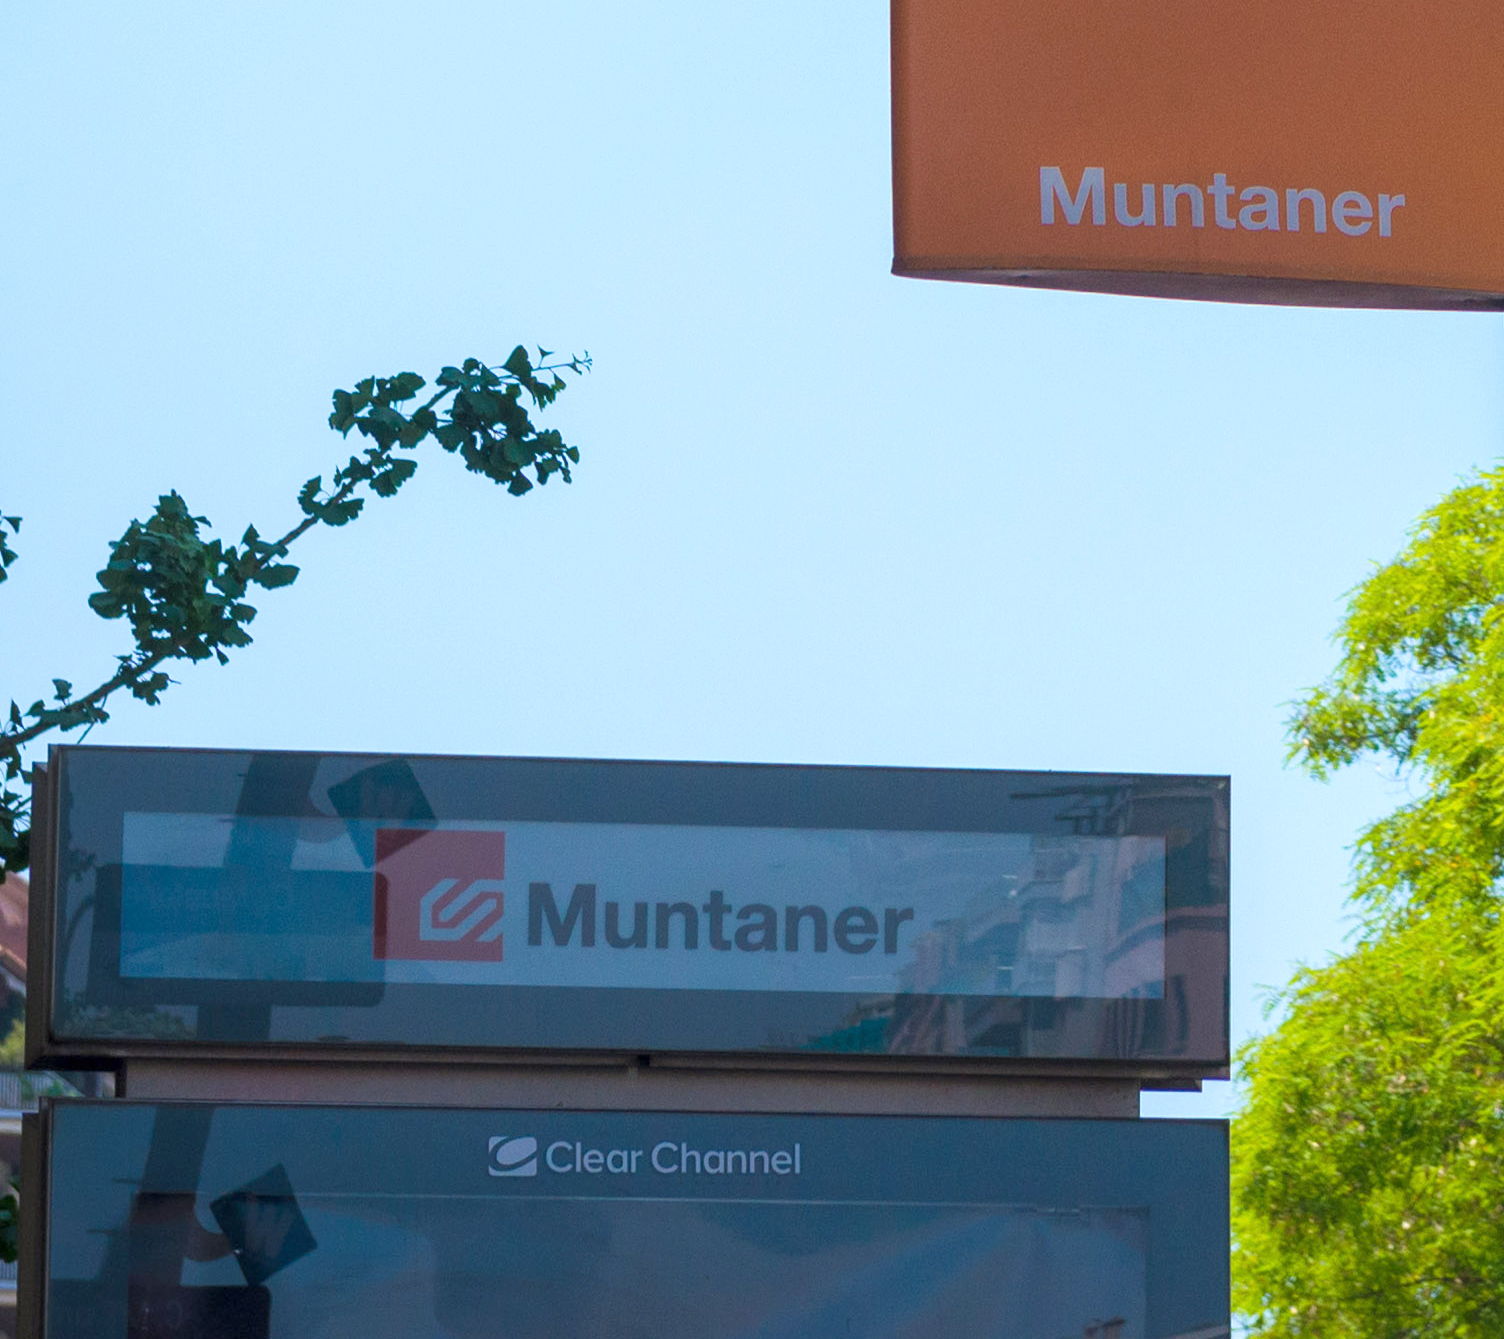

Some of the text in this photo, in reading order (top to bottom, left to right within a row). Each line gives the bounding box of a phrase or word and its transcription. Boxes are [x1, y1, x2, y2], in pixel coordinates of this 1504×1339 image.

[1037, 163, 1407, 240] Muntaner
[526, 881, 915, 956] Muntaner
[544, 1138, 803, 1177] Clear Channel
